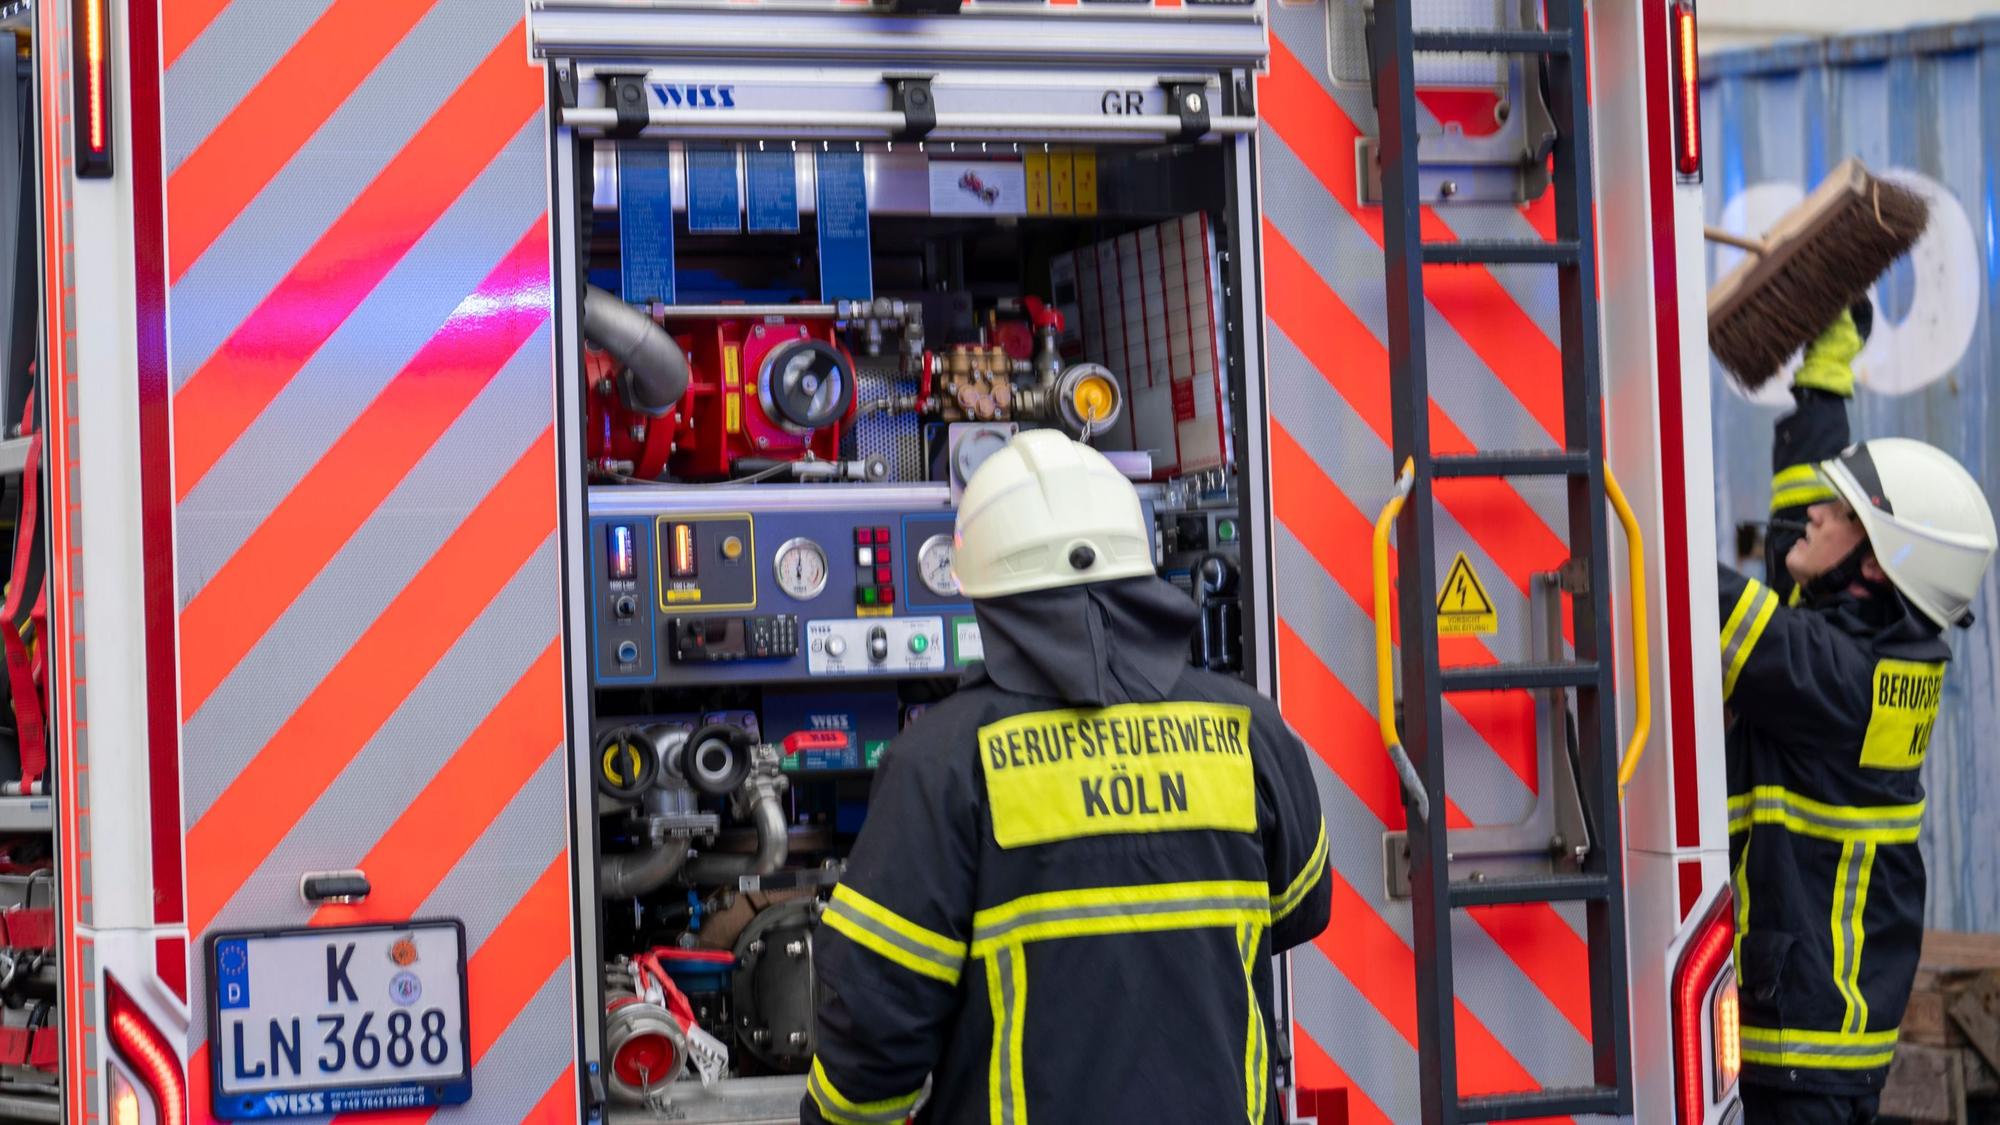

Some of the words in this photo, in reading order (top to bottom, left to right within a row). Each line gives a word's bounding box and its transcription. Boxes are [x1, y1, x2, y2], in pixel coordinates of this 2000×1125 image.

[652, 84, 735, 109] WISS
[1101, 89, 1144, 117] GR
[811, 714, 848, 728] WISS
[988, 714, 1244, 770] BERUFSFEUERWEHR
[1080, 763, 1188, 817] KÖLN
[326, 942, 359, 1003] K
[228, 983, 241, 1004] D
[233, 1016, 301, 1079] LN
[317, 1007, 449, 1073] 3688
[265, 1092, 325, 1116] WISS
